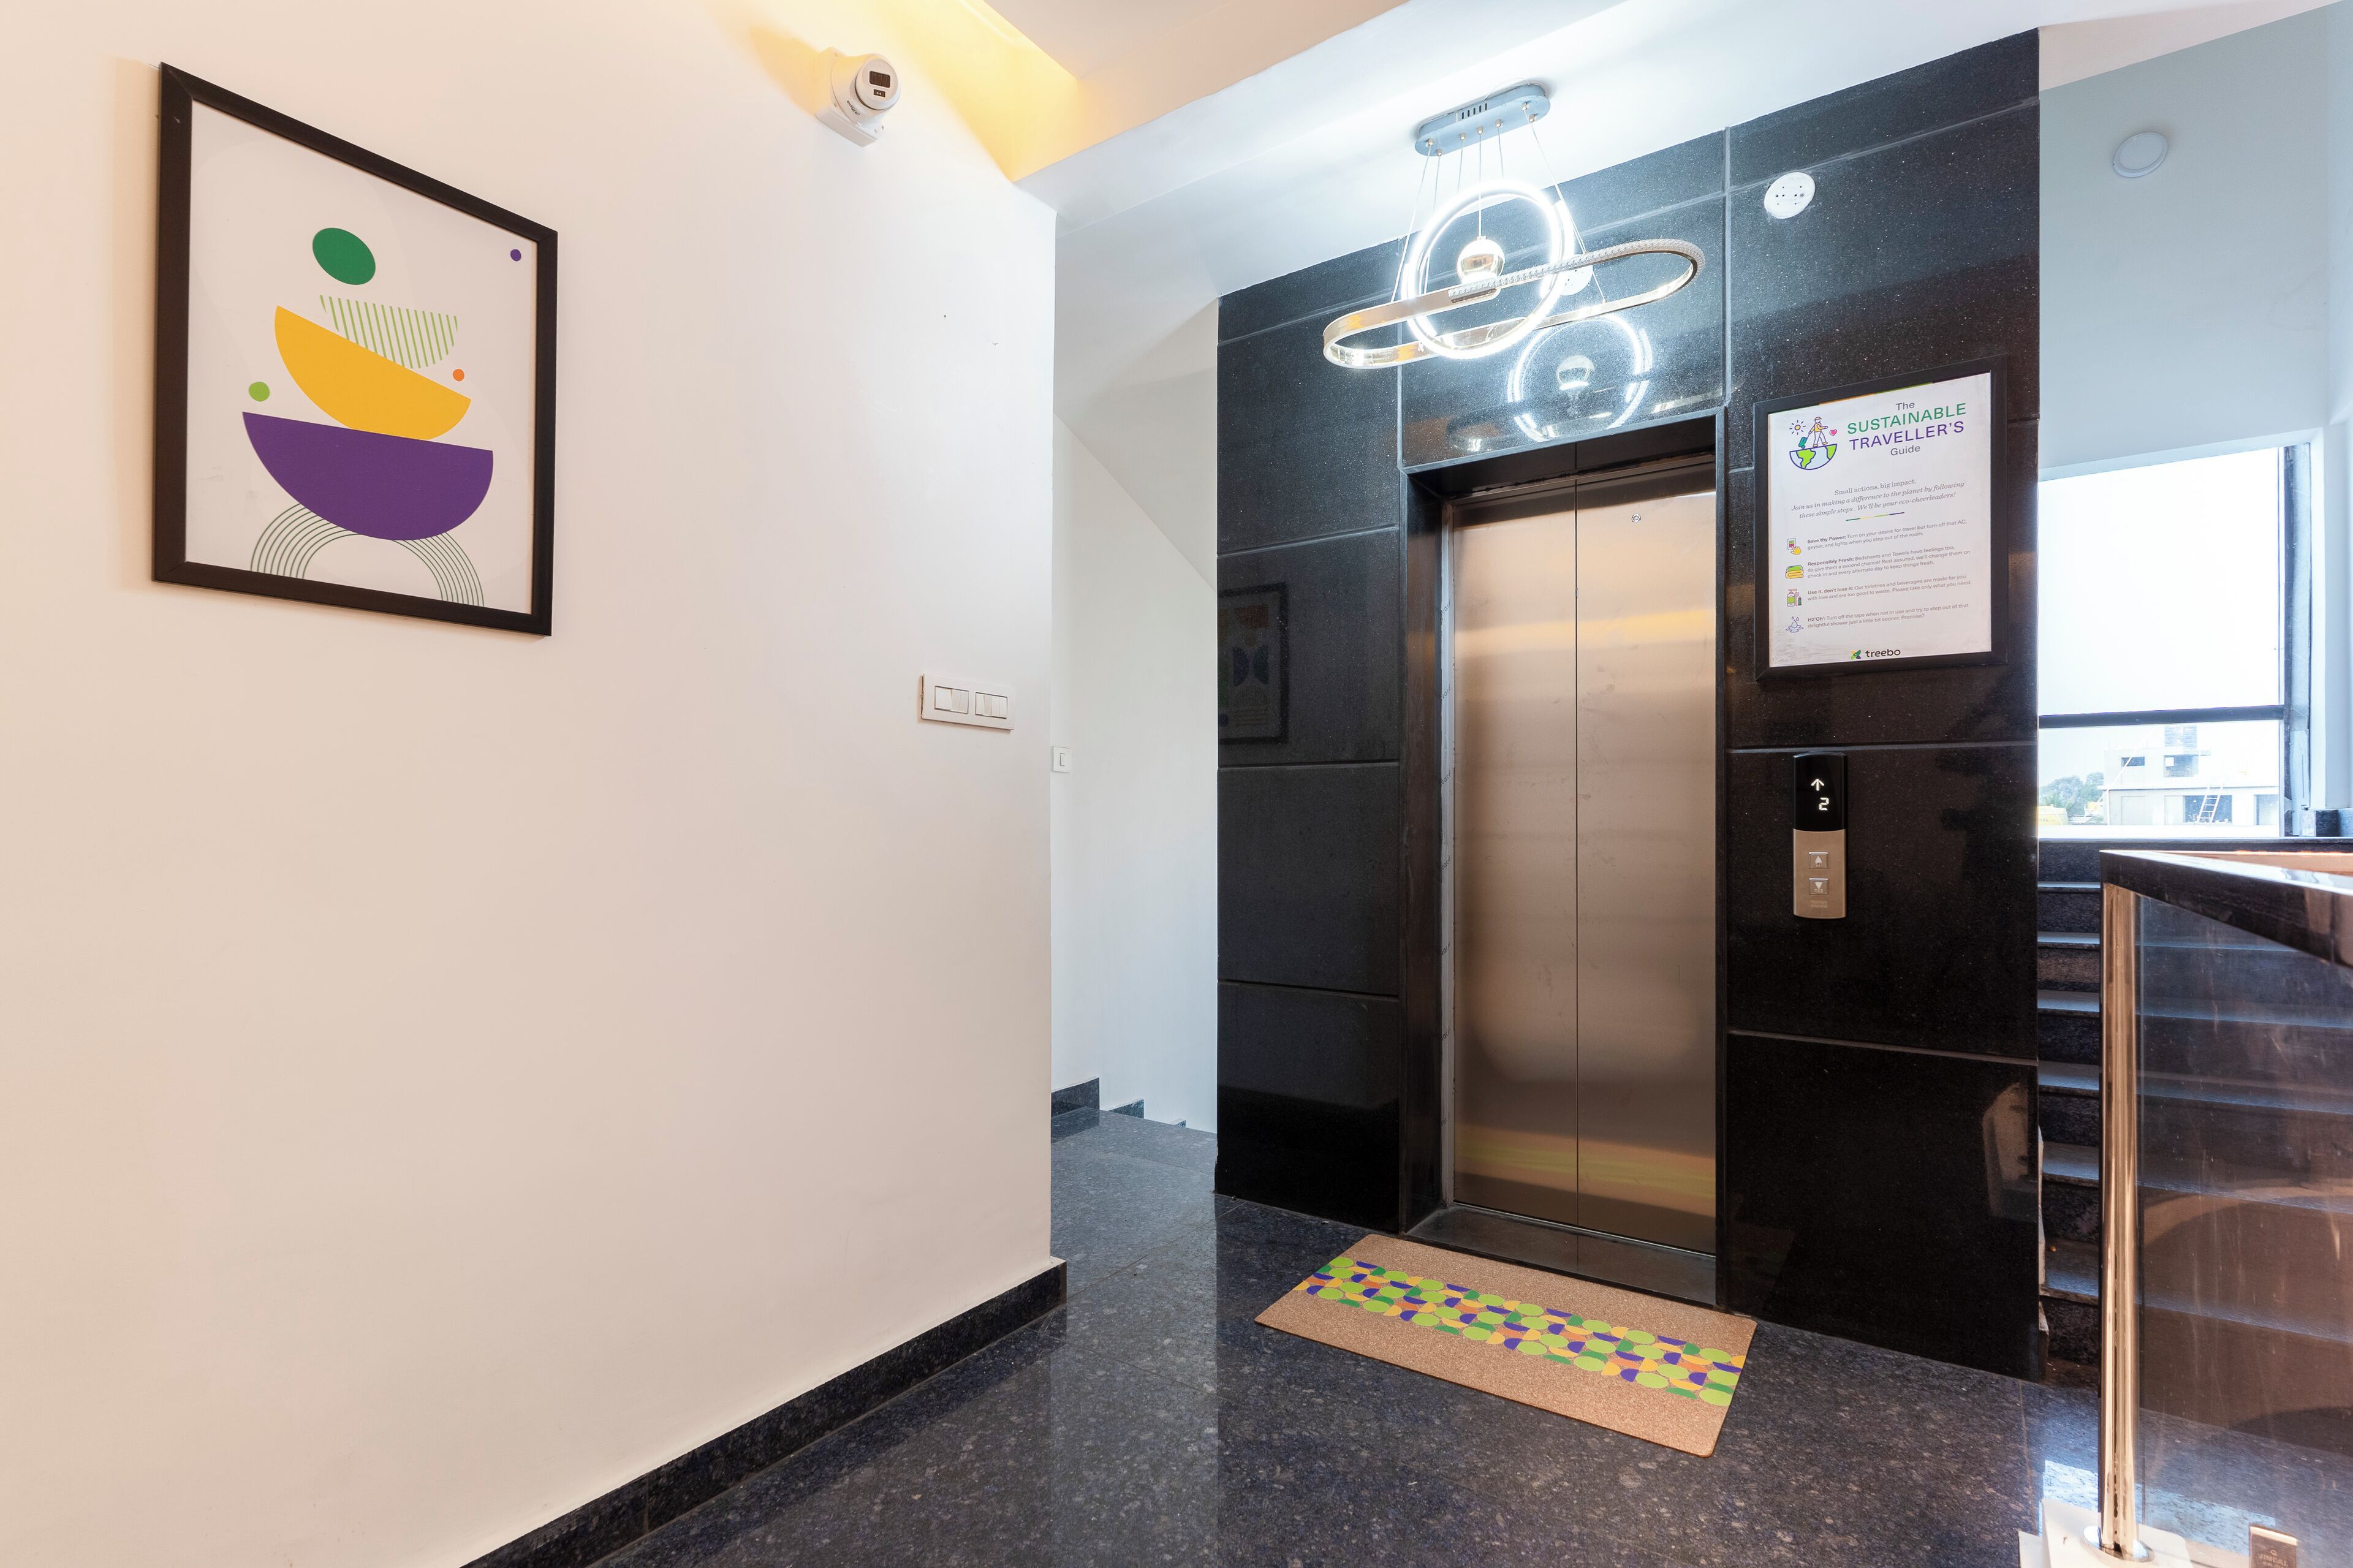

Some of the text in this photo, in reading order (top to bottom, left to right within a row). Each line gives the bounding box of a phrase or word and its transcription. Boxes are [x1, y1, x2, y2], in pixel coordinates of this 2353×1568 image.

[1895, 402, 1915, 411] The
[1847, 403, 1966, 434] SUSTAINABLE
[1849, 420, 1964, 450] TRAVELLER'S
[1890, 445, 1920, 456] Guide
[1891, 479, 1916, 487] impact.
[1851, 494, 1882, 502] difference
[1901, 487, 1923, 496] planet
[1932, 482, 1965, 492] following
[1898, 491, 1956, 505] eco-cheerleaders!
[1865, 648, 1901, 657] treebo
[1819, 797, 1830, 811] 2
